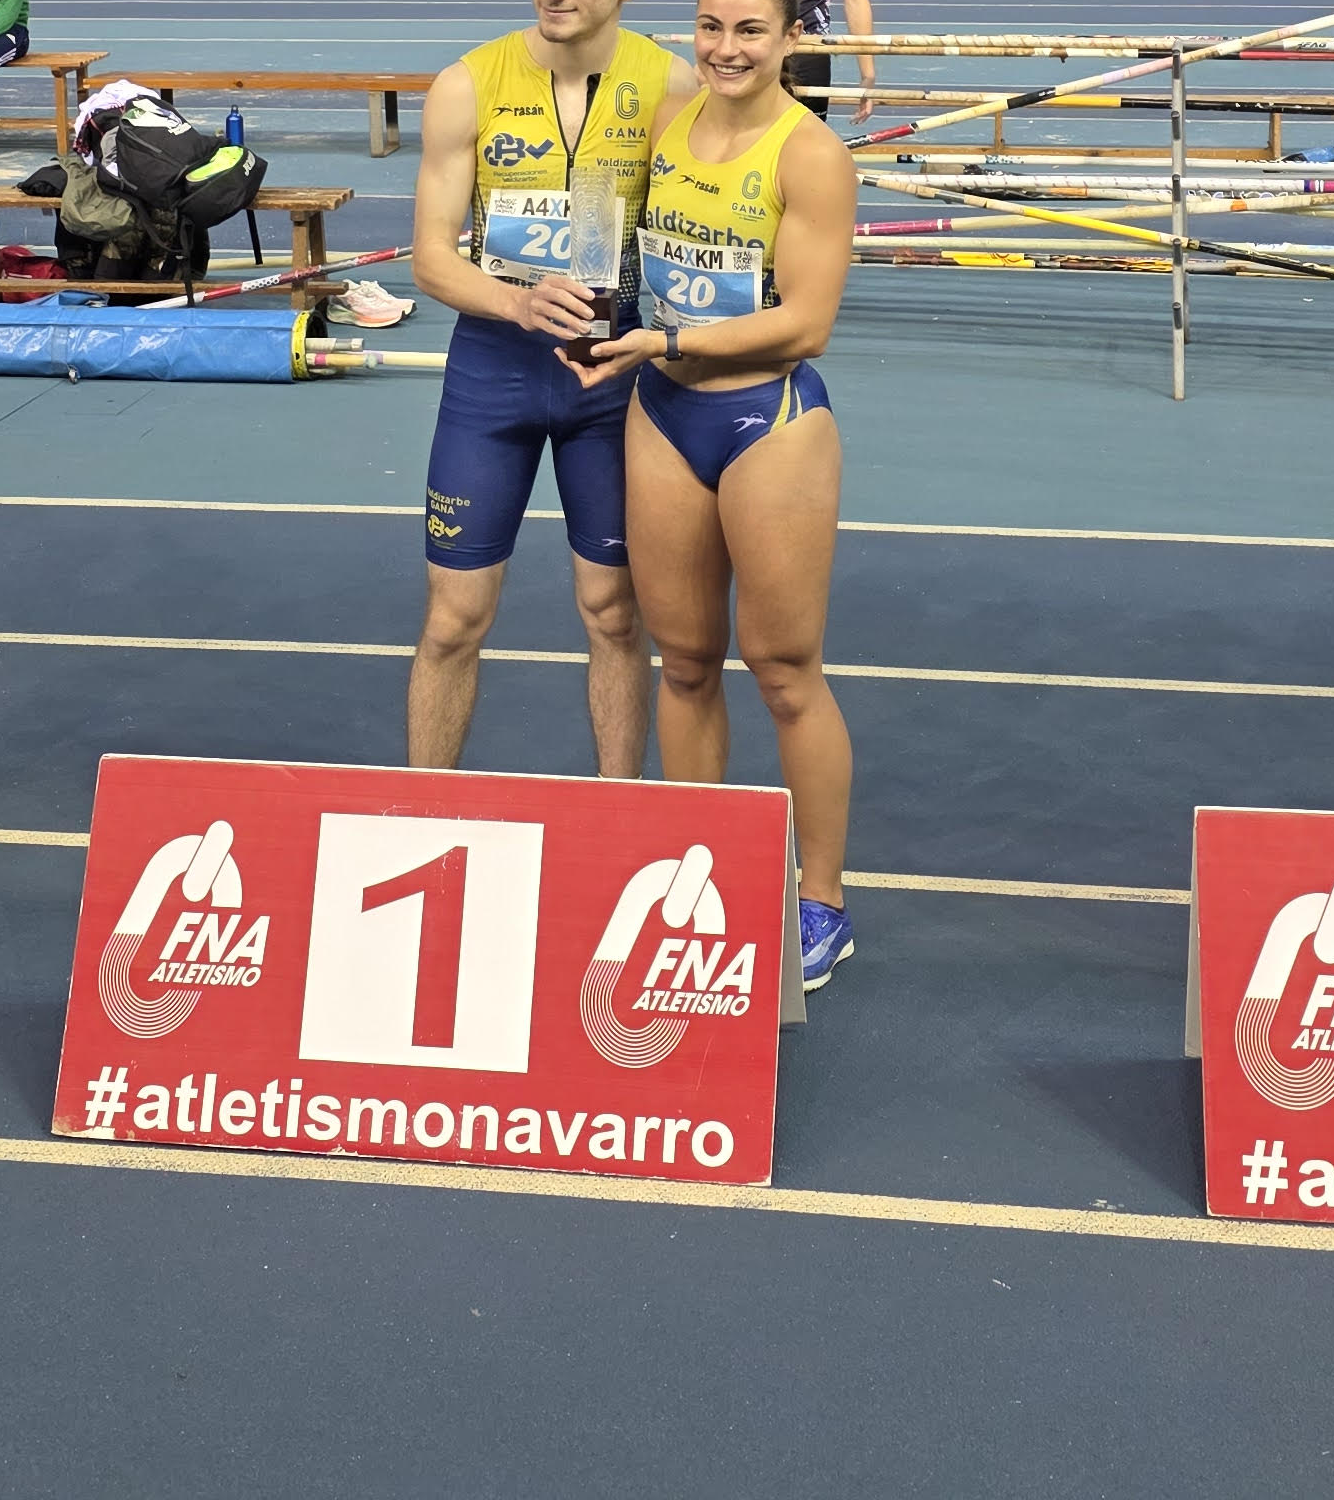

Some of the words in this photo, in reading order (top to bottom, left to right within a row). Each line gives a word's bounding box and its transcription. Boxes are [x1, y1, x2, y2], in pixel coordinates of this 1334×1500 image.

[604, 127, 647, 139] GANA
[596, 156, 648, 167] Valdizarbe
[731, 202, 767, 218] GANA
[663, 240, 724, 270] A4XKM
[666, 269, 716, 308] 20
[430, 499, 455, 516] GANA
[158, 911, 271, 966] FNA
[361, 845, 468, 1049] 1
[148, 961, 262, 988] ATLETISMO
[643, 938, 758, 994] FNA
[632, 989, 752, 1017] ATLETISMO
[85, 1066, 735, 1167] #atletismonavarro
